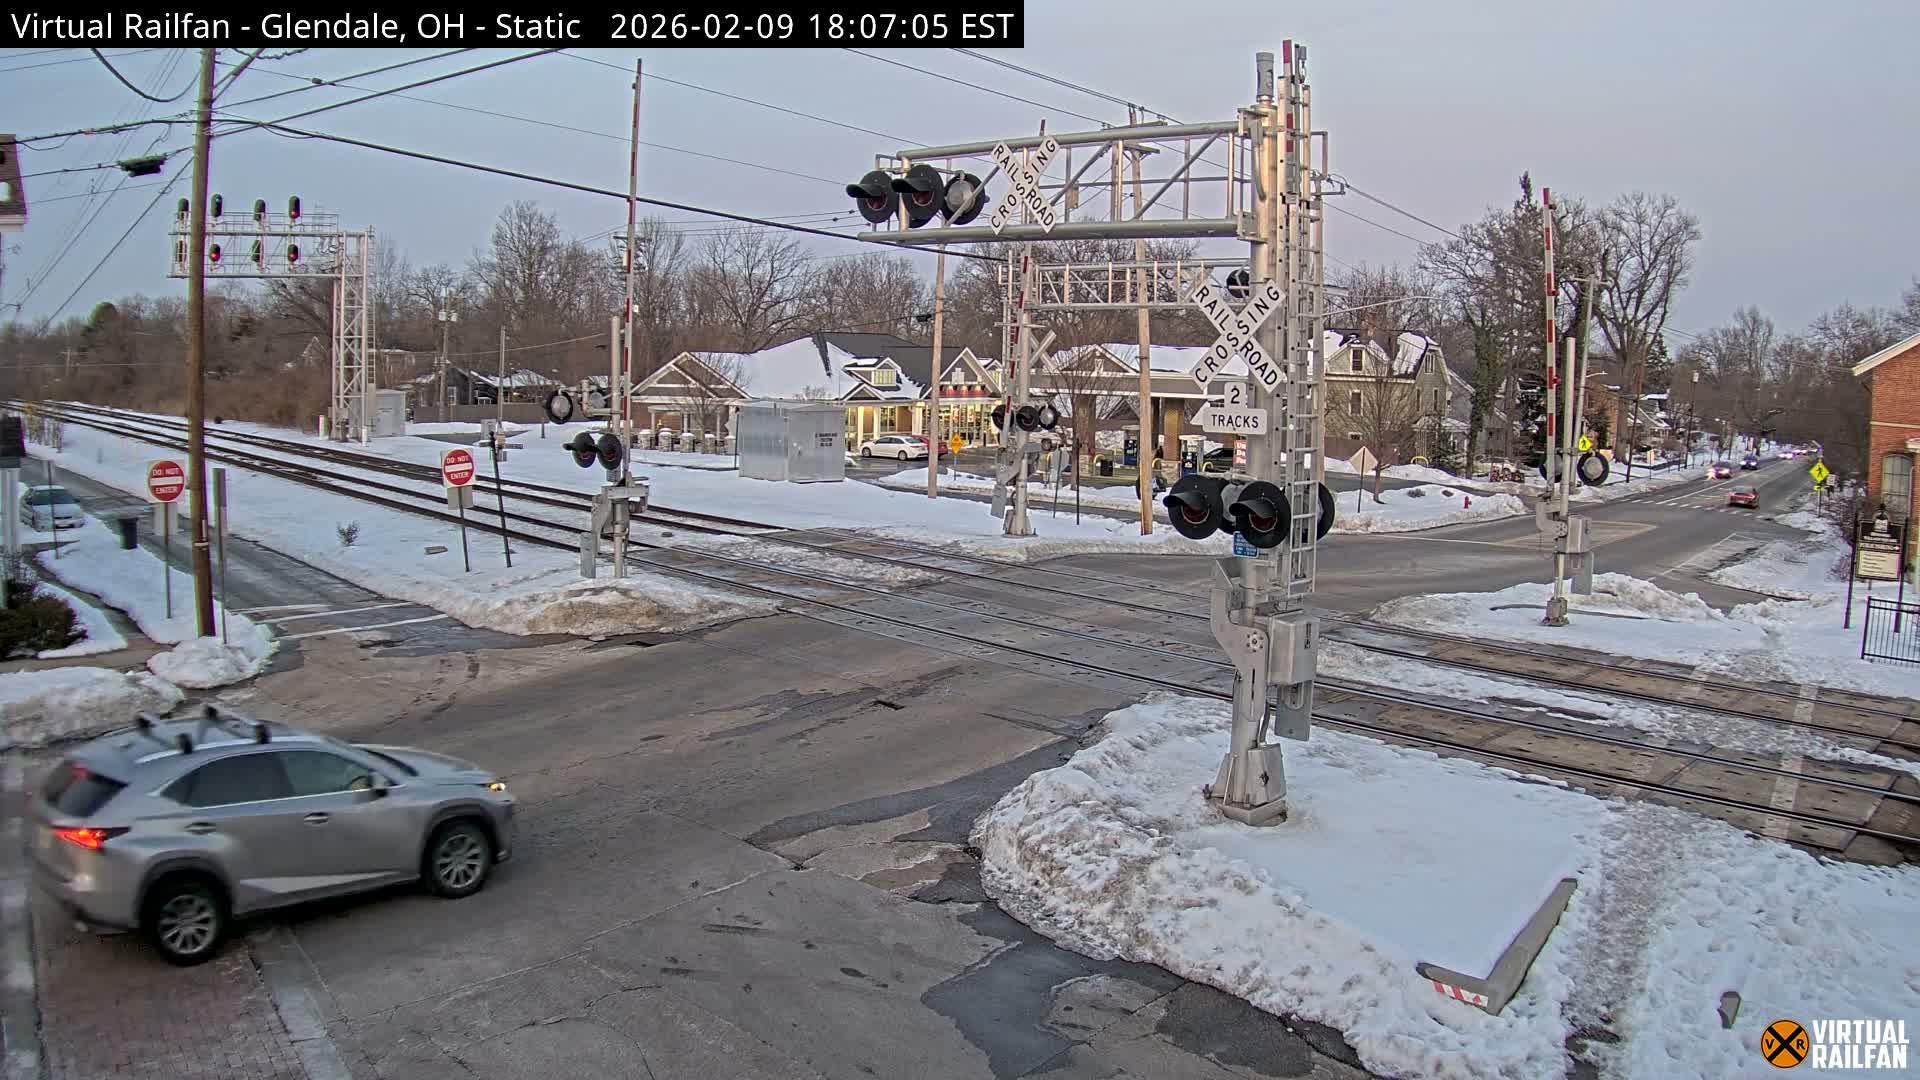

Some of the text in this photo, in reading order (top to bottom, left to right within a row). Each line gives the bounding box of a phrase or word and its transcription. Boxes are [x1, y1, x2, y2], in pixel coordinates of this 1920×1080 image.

[991, 140, 1056, 228] CROSSING
[1195, 286, 1280, 383] CROSSING
[1230, 387, 1240, 404] 2
[1211, 414, 1259, 428] TRACKS
[457, 455, 469, 463] NOT
[451, 472, 469, 480] ENTER
